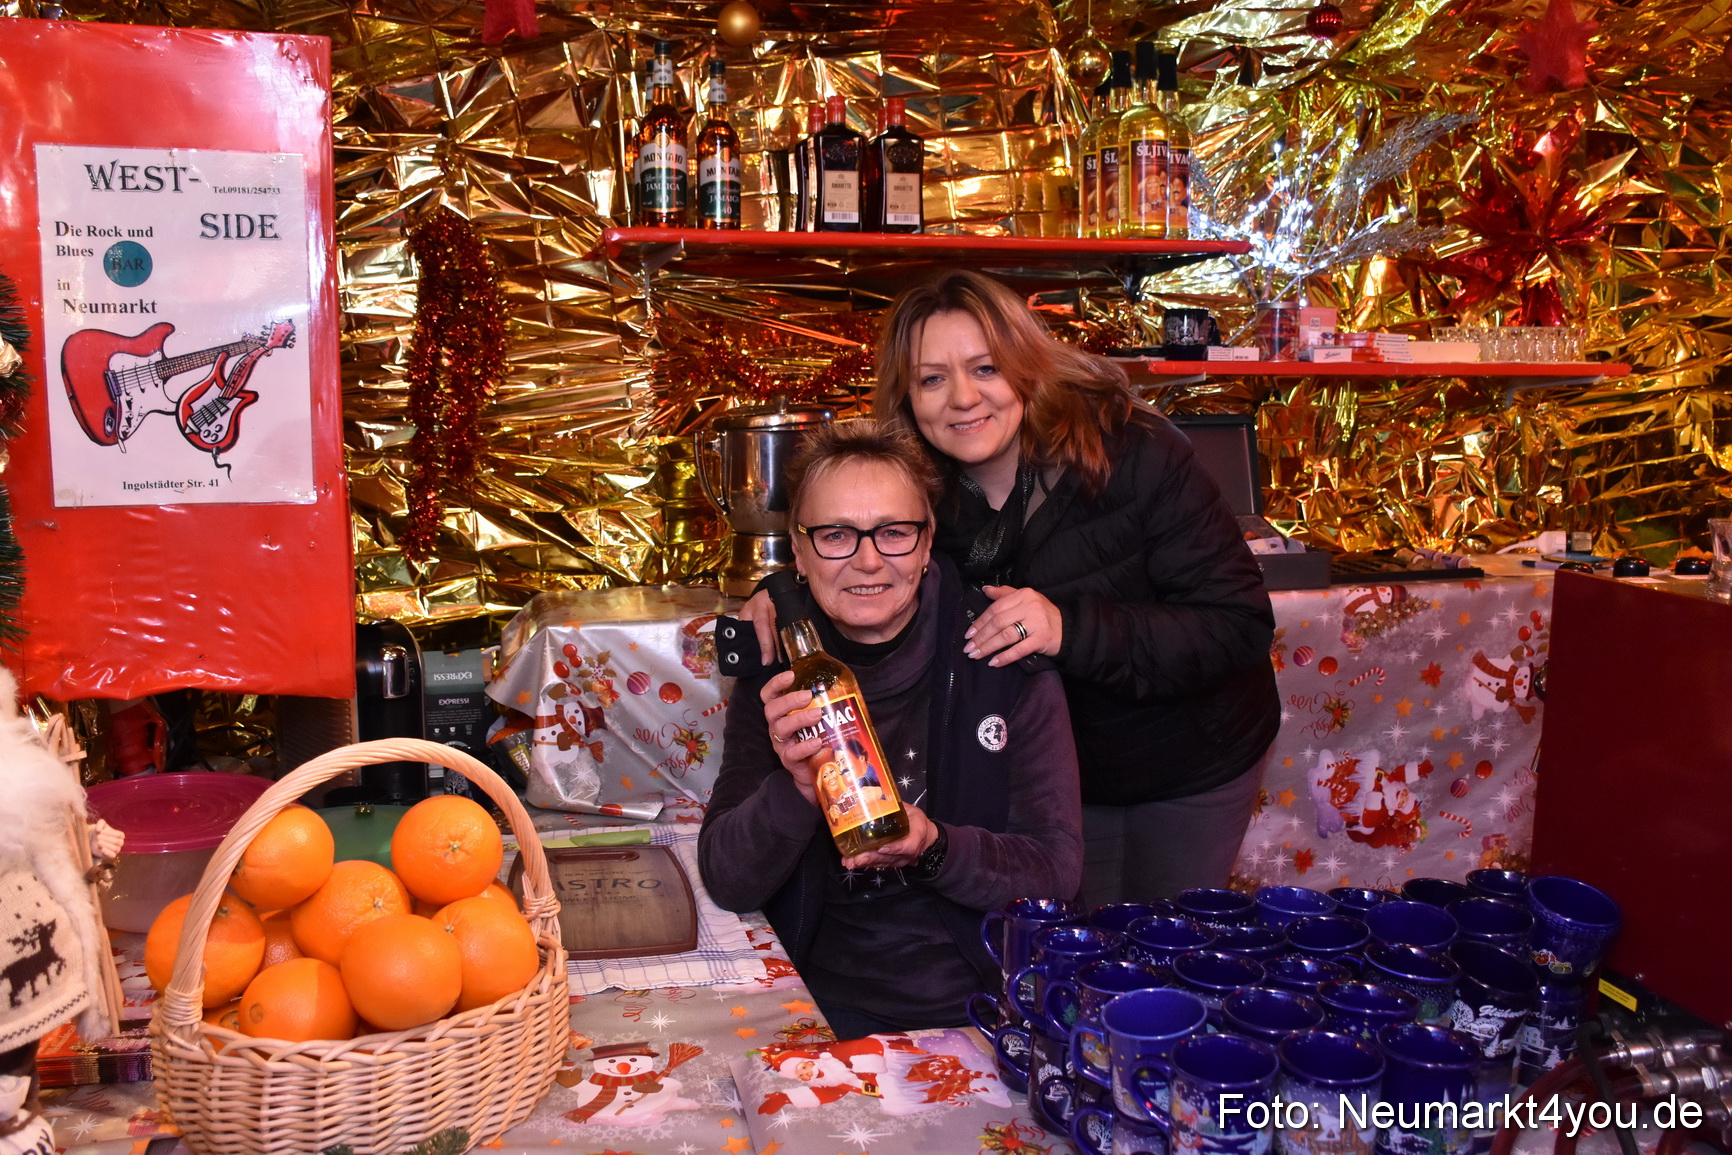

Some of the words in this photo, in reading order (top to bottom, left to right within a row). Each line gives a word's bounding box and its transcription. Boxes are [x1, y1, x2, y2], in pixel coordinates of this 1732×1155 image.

[84, 159, 201, 193] WEST-
[646, 182, 680, 191] JAMAICA
[55, 221, 82, 238] Die
[86, 225, 122, 238] Rock
[128, 226, 153, 238] und
[199, 212, 281, 241] SIDE
[56, 244, 94, 258] Blues
[111, 258, 145, 272] BAR
[57, 279, 70, 291] in
[63, 298, 157, 315] Neumarkt
[122, 479, 184, 492] Ingolstädter
[187, 479, 206, 489] Str.
[208, 479, 219, 488] 41
[434, 671, 472, 682] EXPRESSI
[438, 698, 469, 706] EXPRESSI
